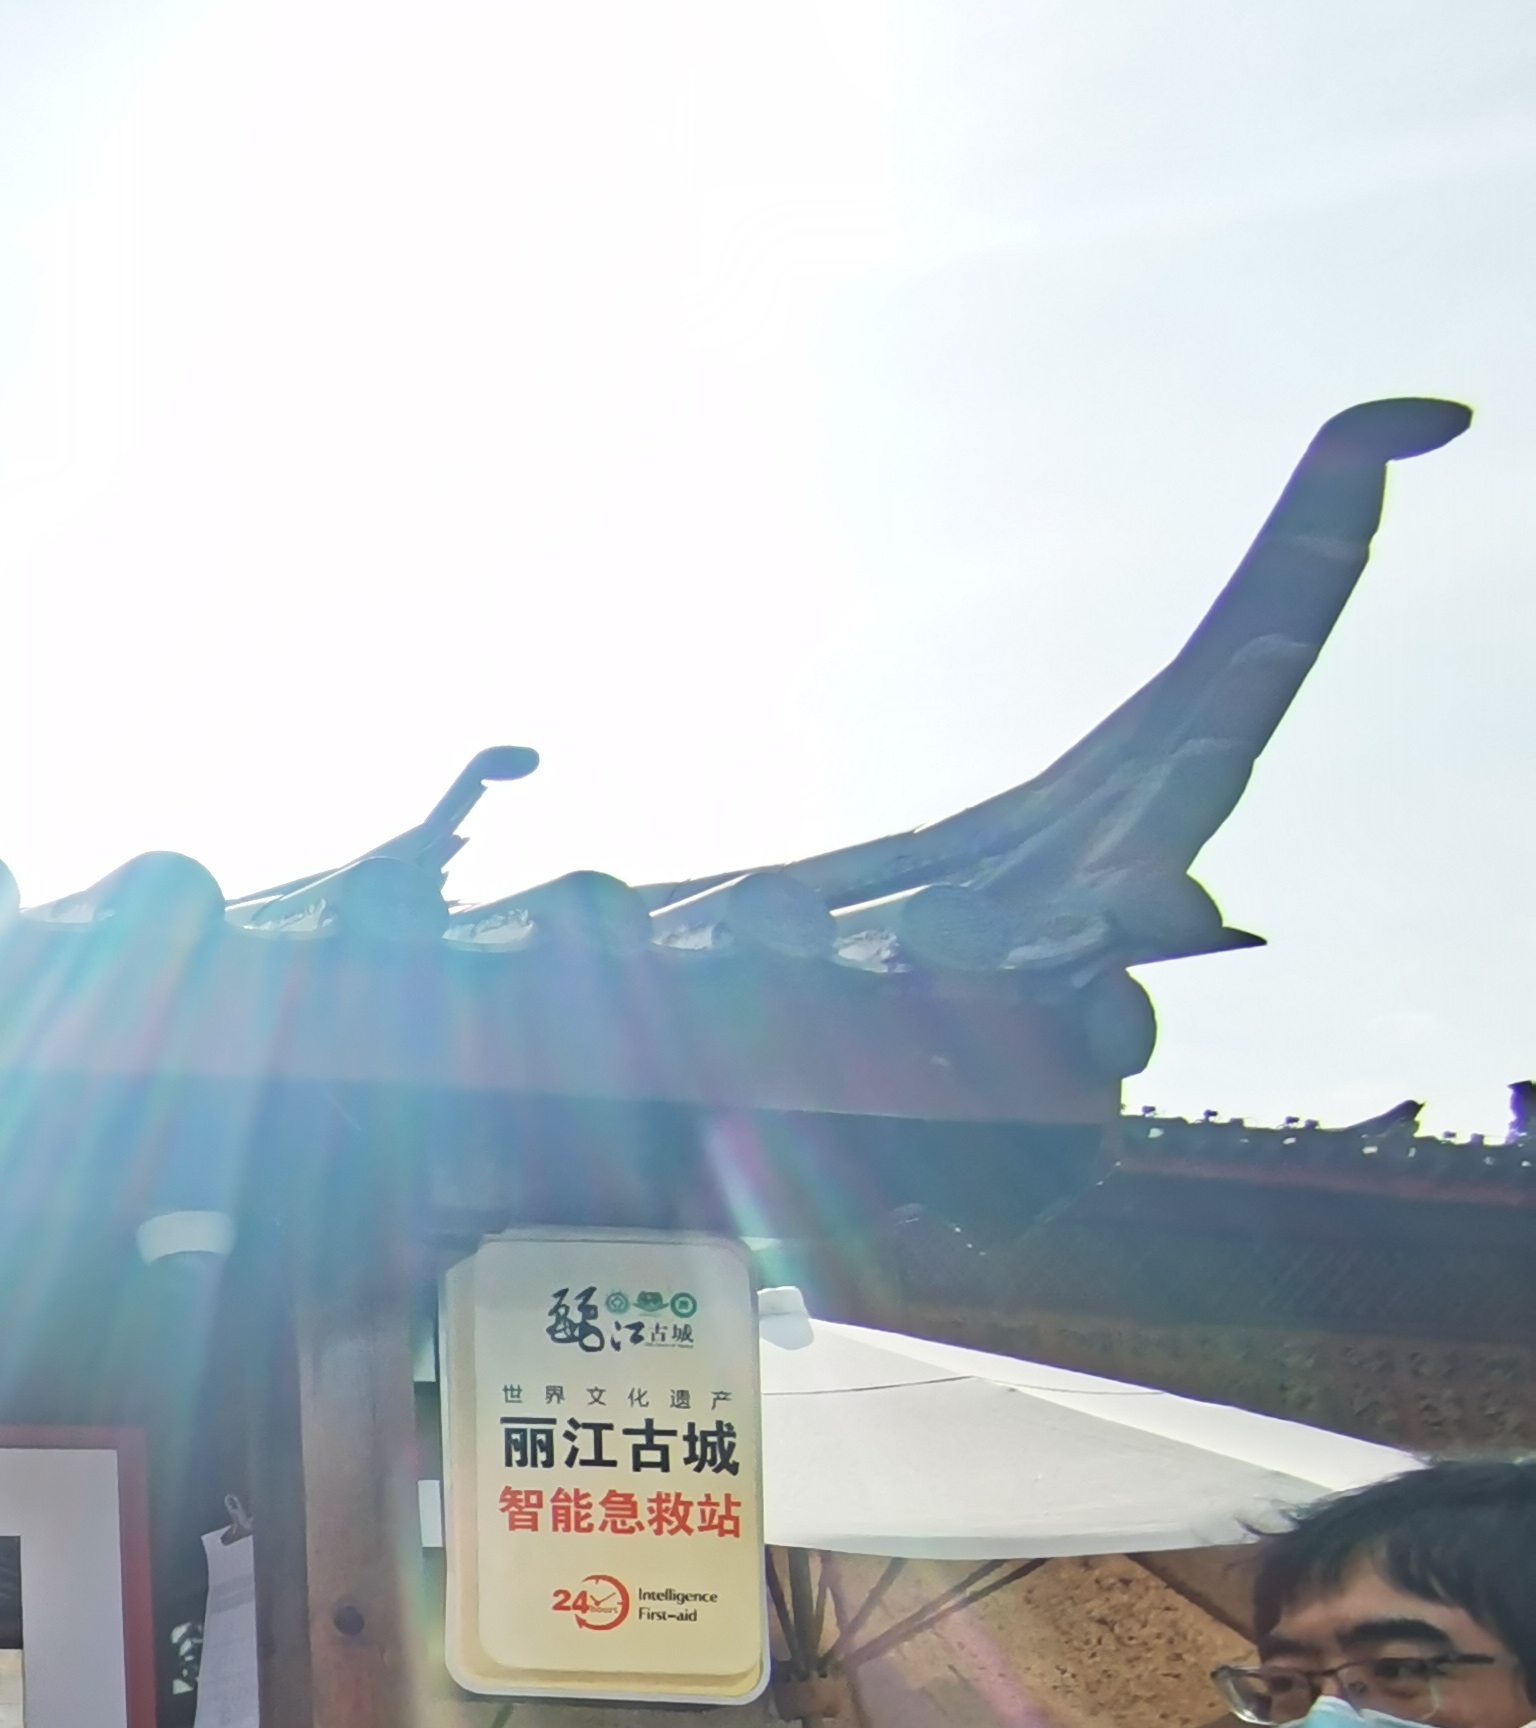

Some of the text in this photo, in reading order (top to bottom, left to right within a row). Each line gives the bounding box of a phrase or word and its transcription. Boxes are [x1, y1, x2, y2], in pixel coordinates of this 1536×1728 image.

[502, 1384, 733, 1411] 世界文化遗产
[500, 1416, 740, 1476] 丽江古城
[499, 1485, 741, 1539] 智能急救站
[552, 1589, 589, 1614] 24
[638, 1587, 718, 1605] Intelligence
[638, 1607, 698, 1622] First-aid
